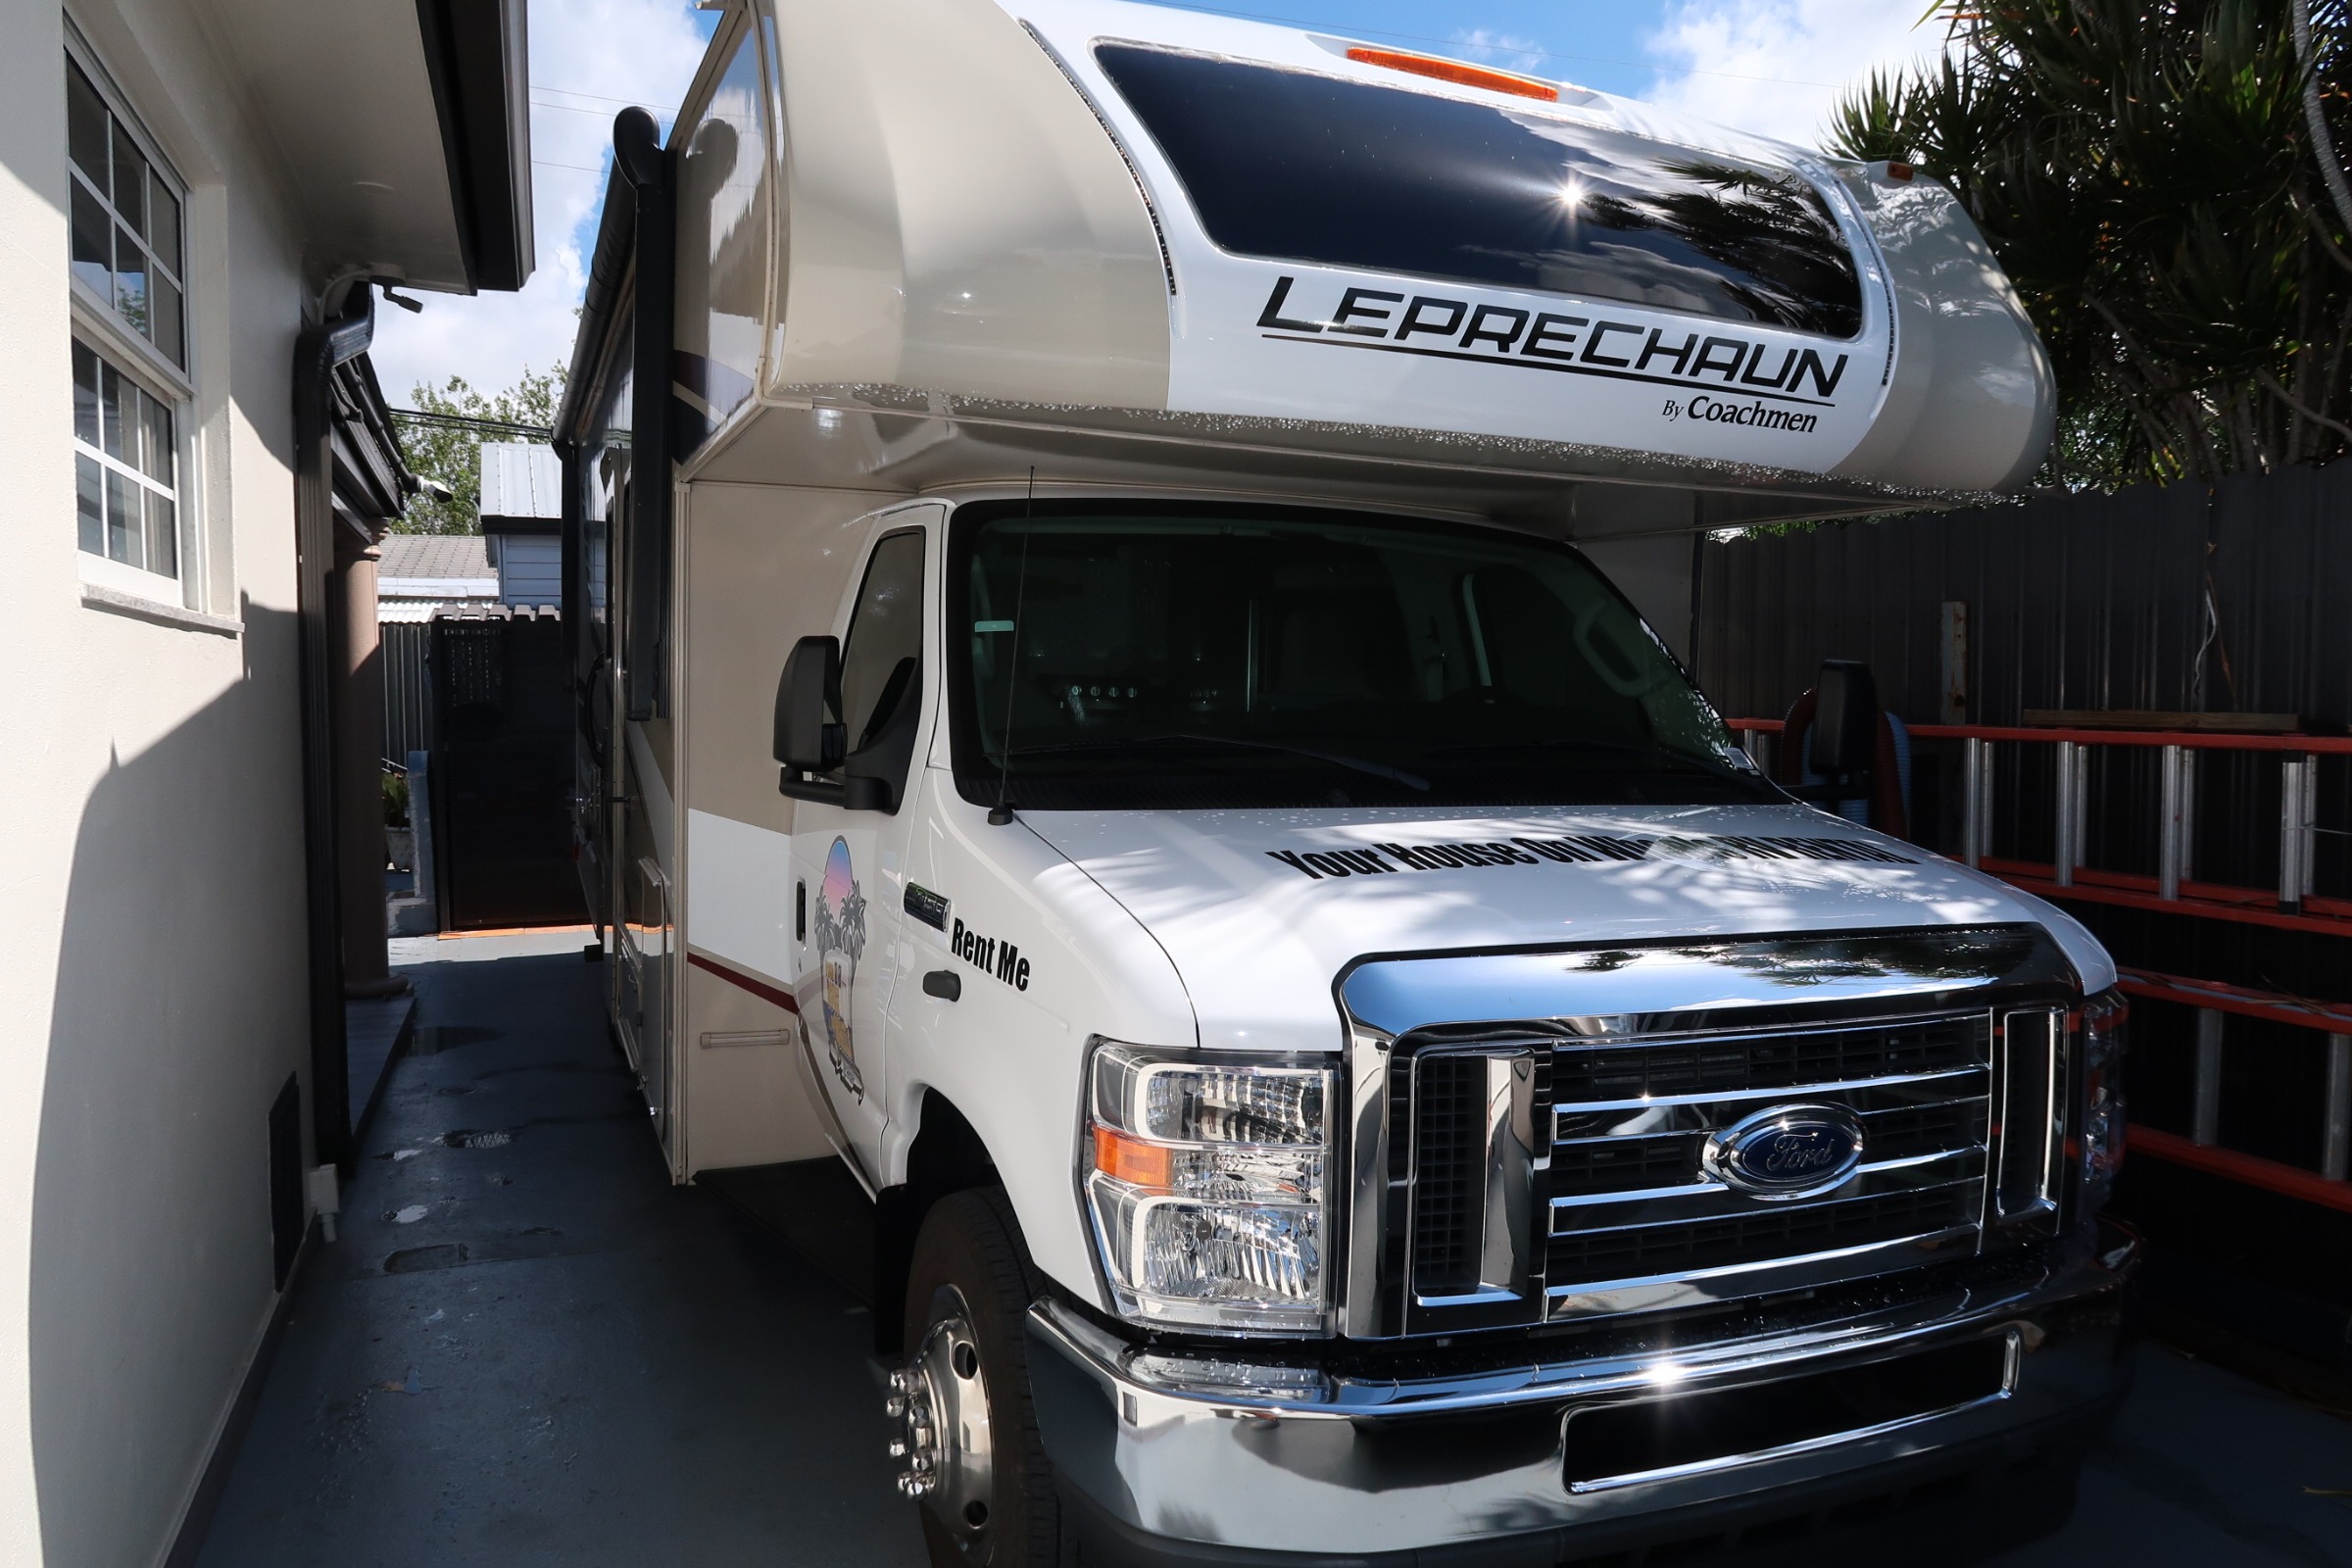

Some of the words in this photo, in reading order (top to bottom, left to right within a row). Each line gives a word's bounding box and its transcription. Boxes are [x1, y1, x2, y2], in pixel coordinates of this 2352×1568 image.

[1256, 275, 1849, 398] LEPRECHAUN
[1662, 399, 1685, 422] By
[1688, 395, 1818, 433] Coachmen
[1264, 849, 1399, 880] Your
[1372, 842, 1541, 871] House
[1510, 837, 1603, 863] On
[1708, 835, 1799, 860] RV
[1757, 835, 1922, 865] RENTAL
[951, 917, 996, 975] Rent
[996, 940, 1031, 992] Me
[1766, 1131, 1836, 1172] Ford
